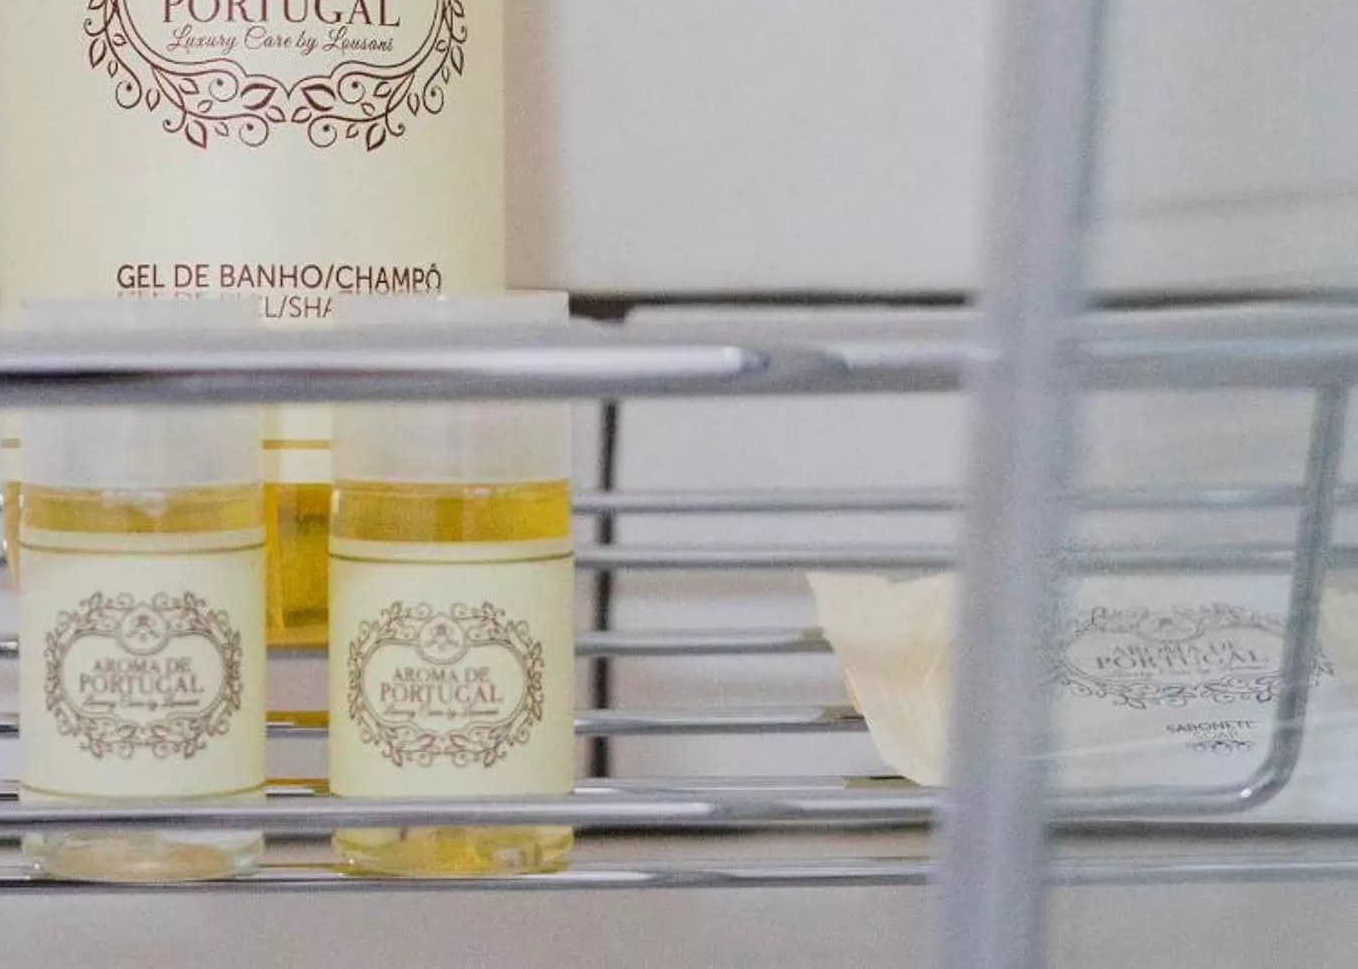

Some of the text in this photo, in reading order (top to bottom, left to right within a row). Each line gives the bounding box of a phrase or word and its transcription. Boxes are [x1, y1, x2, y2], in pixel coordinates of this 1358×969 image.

[167, 23, 239, 55] Luxury
[243, 25, 292, 50] Care
[294, 29, 319, 55] by
[117, 264, 165, 289] GEL
[174, 264, 210, 288] DE
[78, 673, 206, 695] PORTUGAL
[379, 682, 504, 704] PORTUGAL
